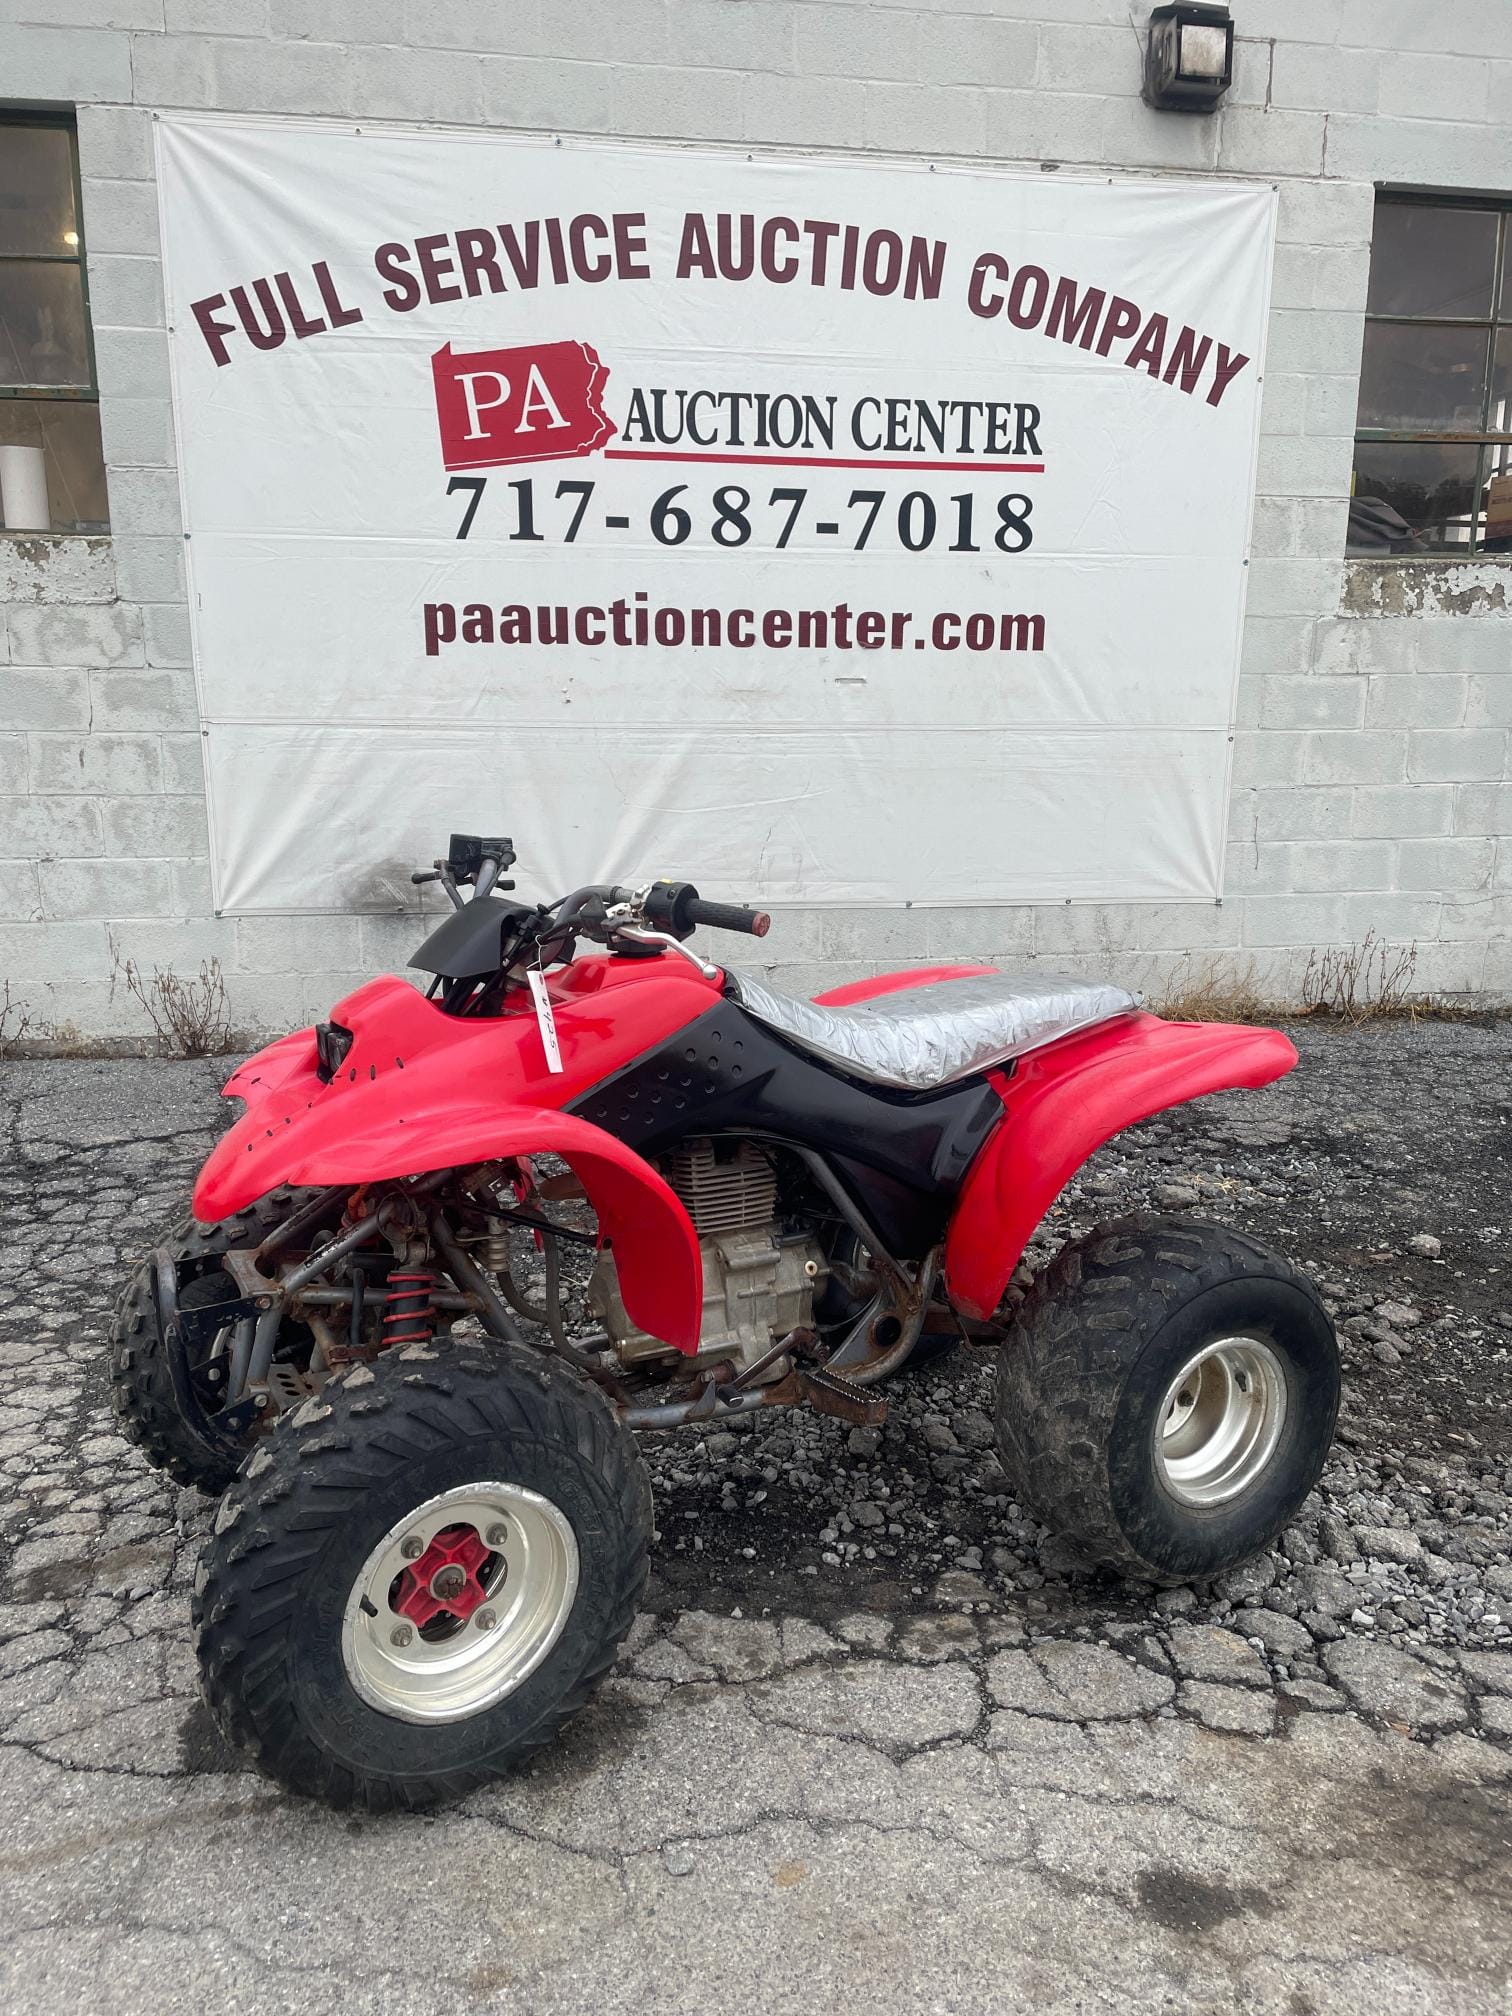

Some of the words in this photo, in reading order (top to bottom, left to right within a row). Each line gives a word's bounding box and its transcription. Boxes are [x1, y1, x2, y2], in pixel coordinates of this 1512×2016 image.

[189, 260, 364, 368] FULL
[374, 212, 651, 313] SERVICE
[675, 212, 947, 301] AUCTION
[967, 252, 1251, 408] COMPANY
[453, 363, 572, 440] PA
[621, 387, 838, 450] AUCTION
[851, 396, 1043, 456] CENTER
[445, 476, 1033, 554] 717-687-7018
[423, 591, 1046, 657] paauctioncenter.com
